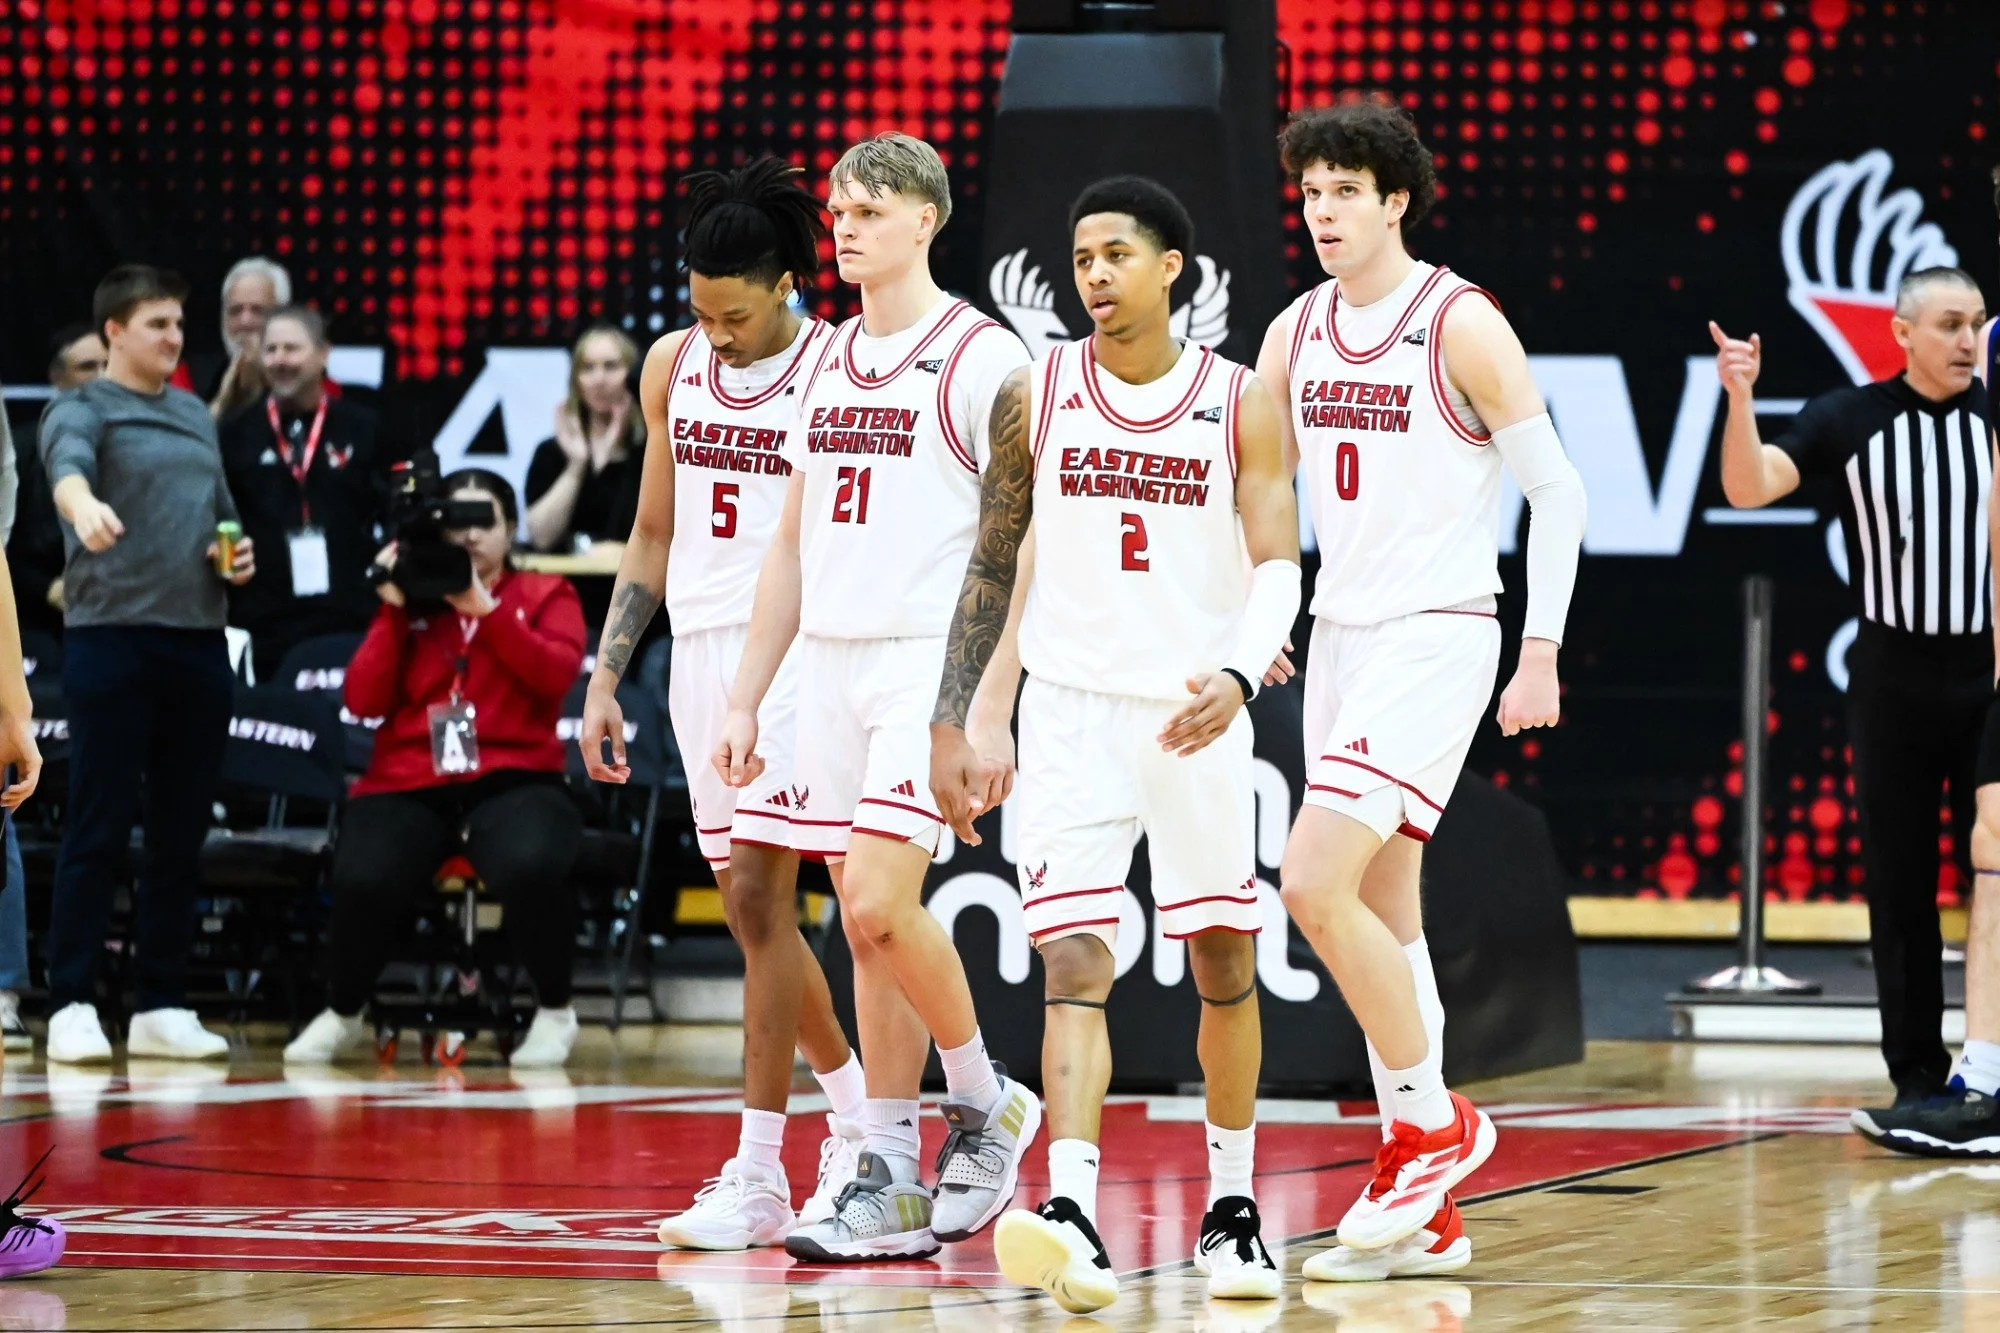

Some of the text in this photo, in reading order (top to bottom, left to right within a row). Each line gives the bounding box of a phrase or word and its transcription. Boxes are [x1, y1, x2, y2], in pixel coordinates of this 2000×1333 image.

[1301, 380, 1414, 407] EASTERN
[809, 407, 921, 433] EASTERN
[1301, 405, 1412, 432] WASHINGTON
[807, 431, 916, 457] WASHINGTON
[1060, 448, 1212, 481] EASTERN
[1336, 442, 1359, 501] 0
[832, 466, 871, 524] 21
[1060, 474, 1209, 506] WASHINGTON
[712, 481, 740, 538] 5
[1121, 512, 1150, 572] 2
[228, 716, 317, 752] STERN
